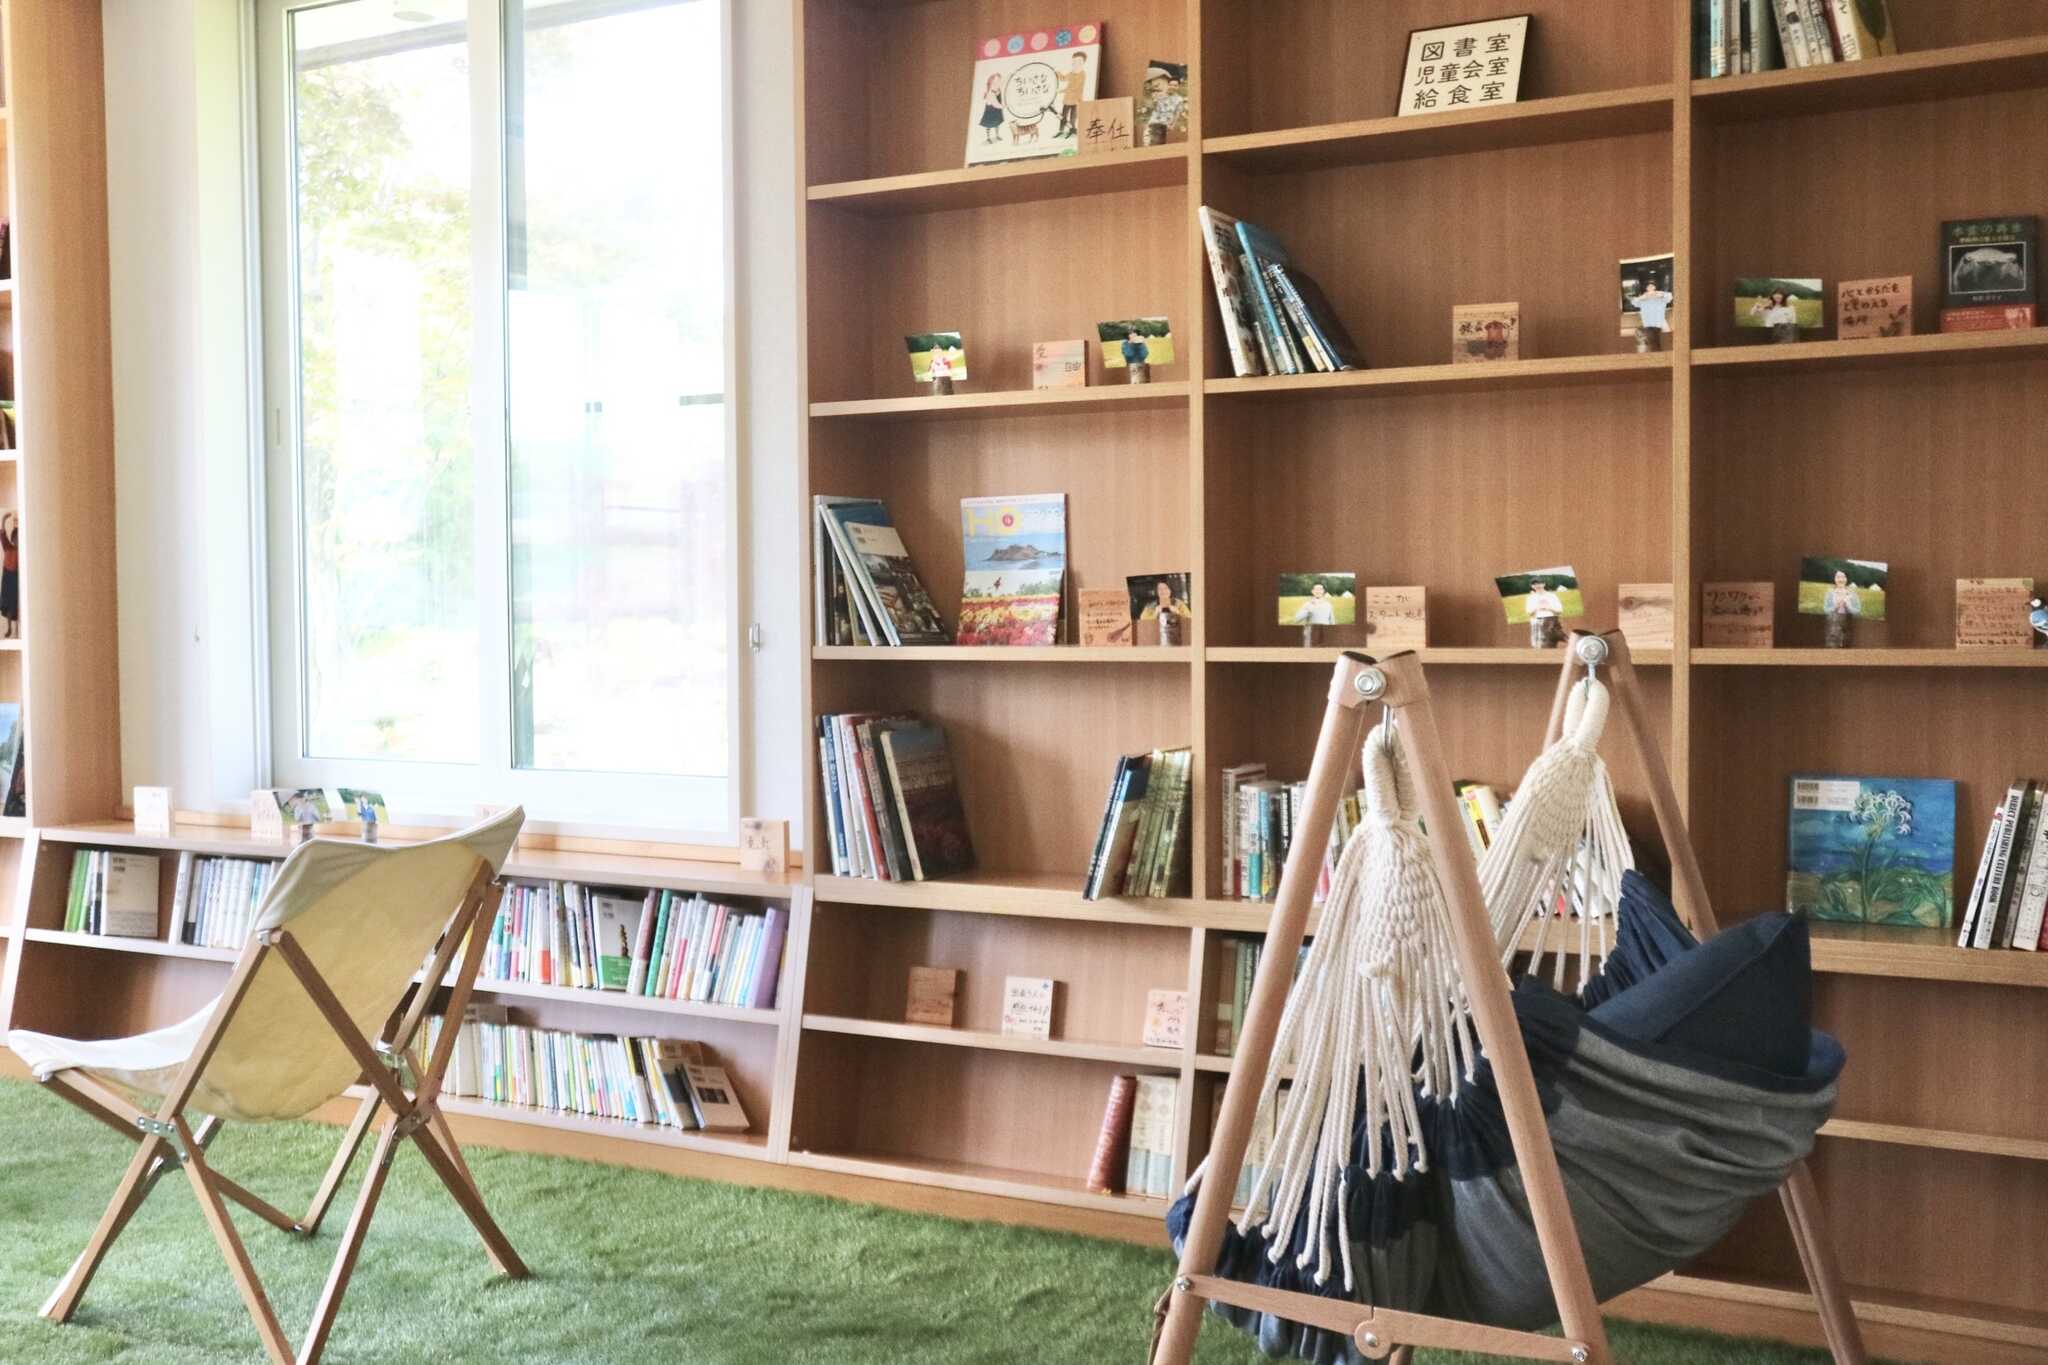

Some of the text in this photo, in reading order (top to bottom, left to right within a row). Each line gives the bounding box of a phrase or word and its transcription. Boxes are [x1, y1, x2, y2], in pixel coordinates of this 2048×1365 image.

[1420, 33, 1511, 62] 図書室
[1414, 56, 1509, 87] 児童会室
[1413, 80, 1505, 110] 給食室
